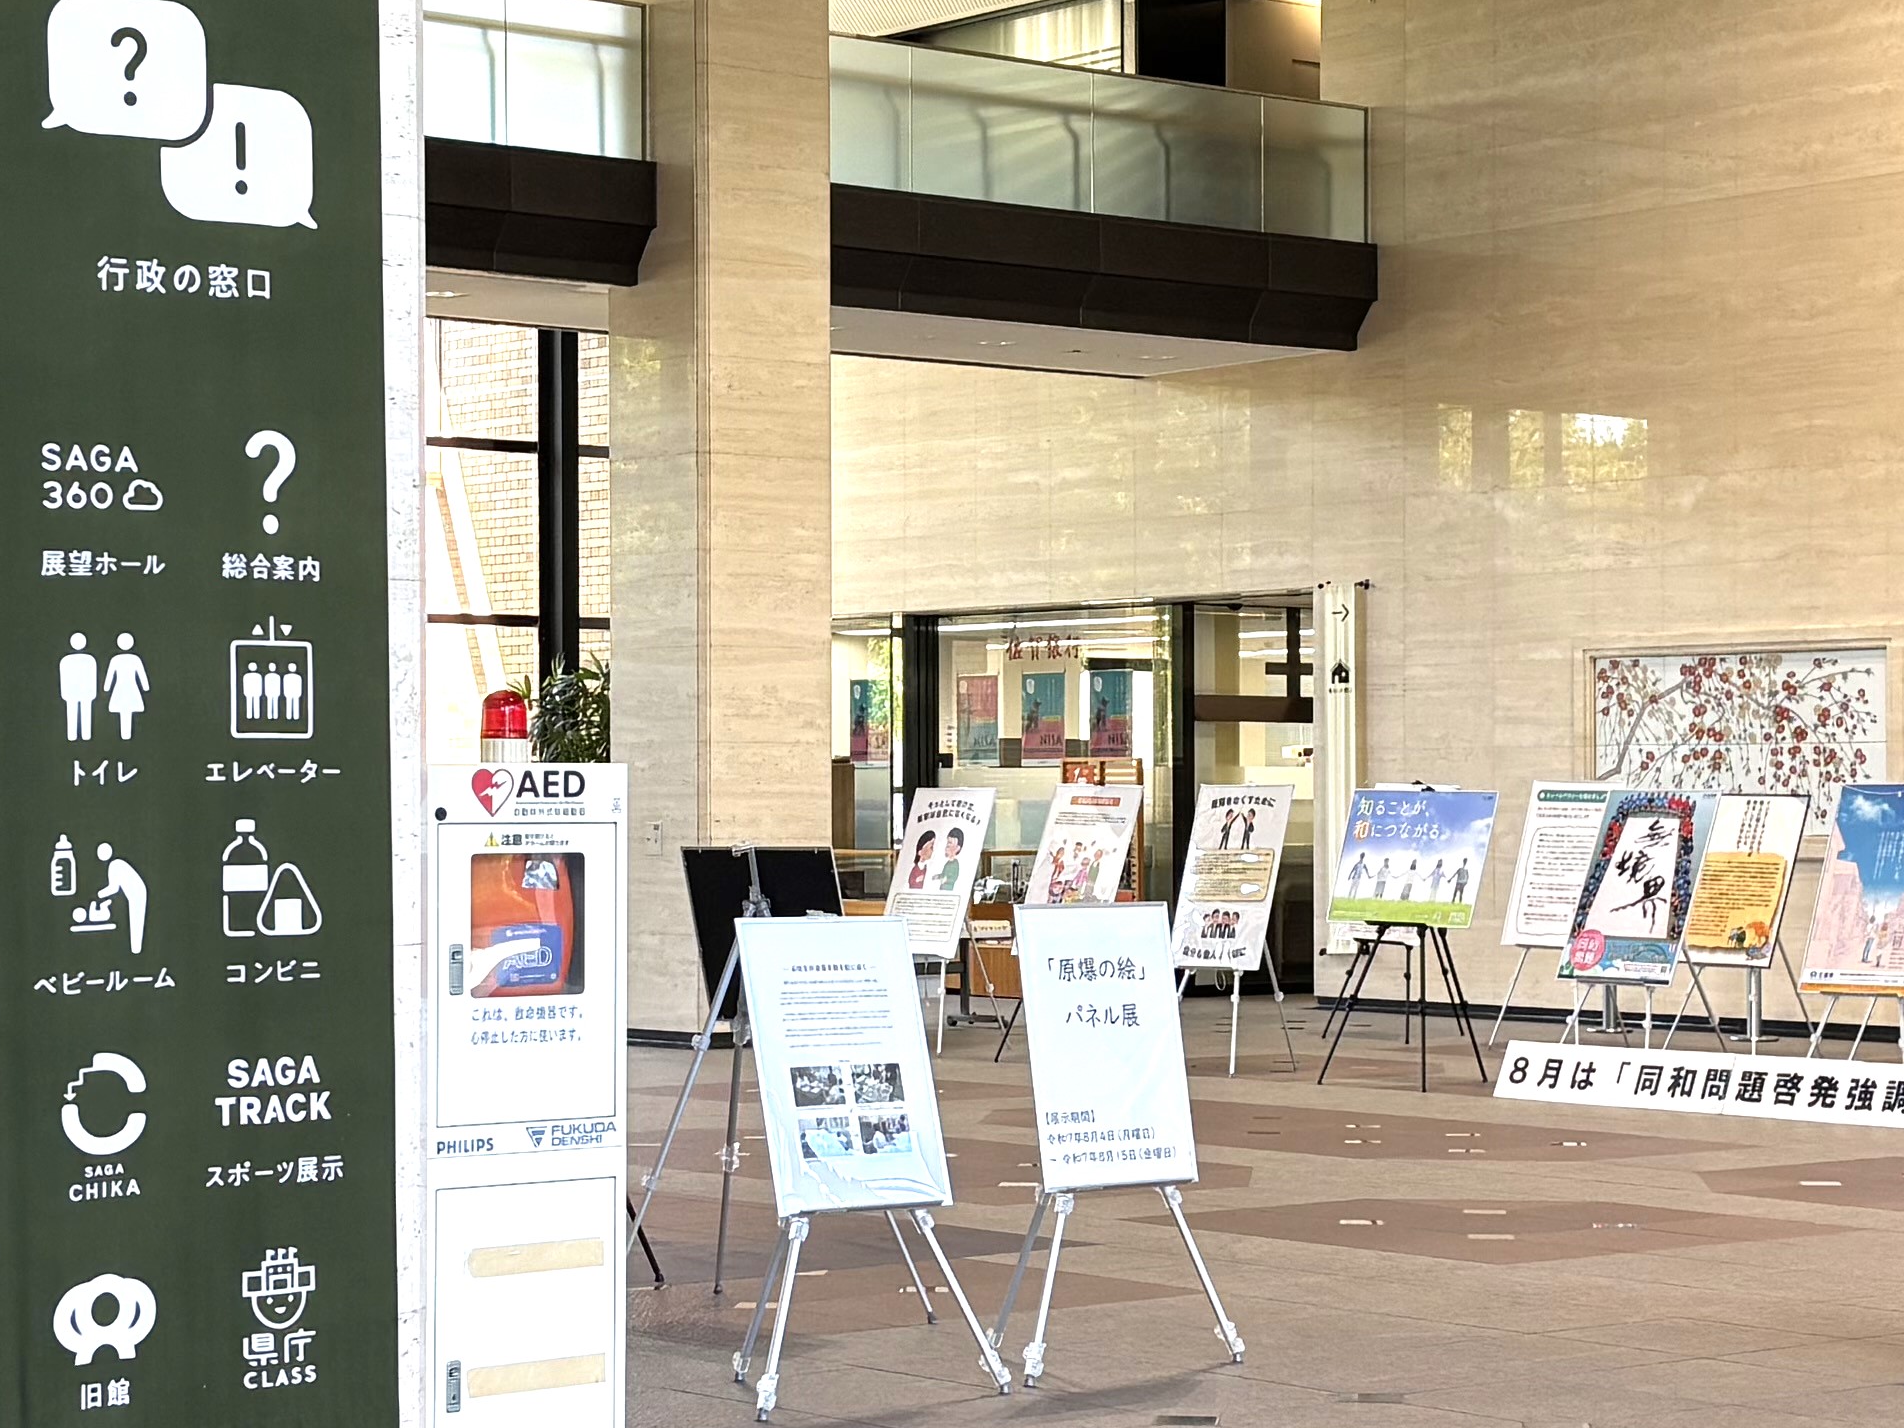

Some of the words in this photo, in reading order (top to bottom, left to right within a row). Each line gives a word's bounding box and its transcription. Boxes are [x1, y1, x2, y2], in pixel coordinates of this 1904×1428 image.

[96, 255, 273, 300] 行政の窓口
[41, 442, 139, 474] SAGA
[42, 480, 114, 510] 360
[40, 550, 166, 577] 展望ホール
[222, 552, 322, 583] 総合案内
[73, 760, 138, 786] トイレ
[204, 759, 341, 784] エレベーター
[516, 770, 586, 798] AED
[1357, 796, 1430, 817] 知ることが、
[1354, 821, 1446, 840] 和につながる。
[33, 967, 176, 995] ベビールーム
[226, 960, 321, 983] コンビニ
[1046, 956, 1146, 982] 「原爆の絵」
[1066, 1003, 1140, 1028] パネル展
[226, 1055, 321, 1088] SAGA
[215, 1090, 333, 1127] TRACK
[551, 1121, 617, 1136] FUKUDA
[551, 1134, 603, 1147] DENSHI
[436, 1138, 494, 1155] PHILIPS
[84, 1163, 125, 1178] SAGA
[205, 1154, 345, 1188] スポーツ展示
[68, 1179, 142, 1202] CHIKA
[243, 1329, 316, 1366] 県庁
[243, 1364, 317, 1390] CLASS
[80, 1377, 131, 1410] 旧館
